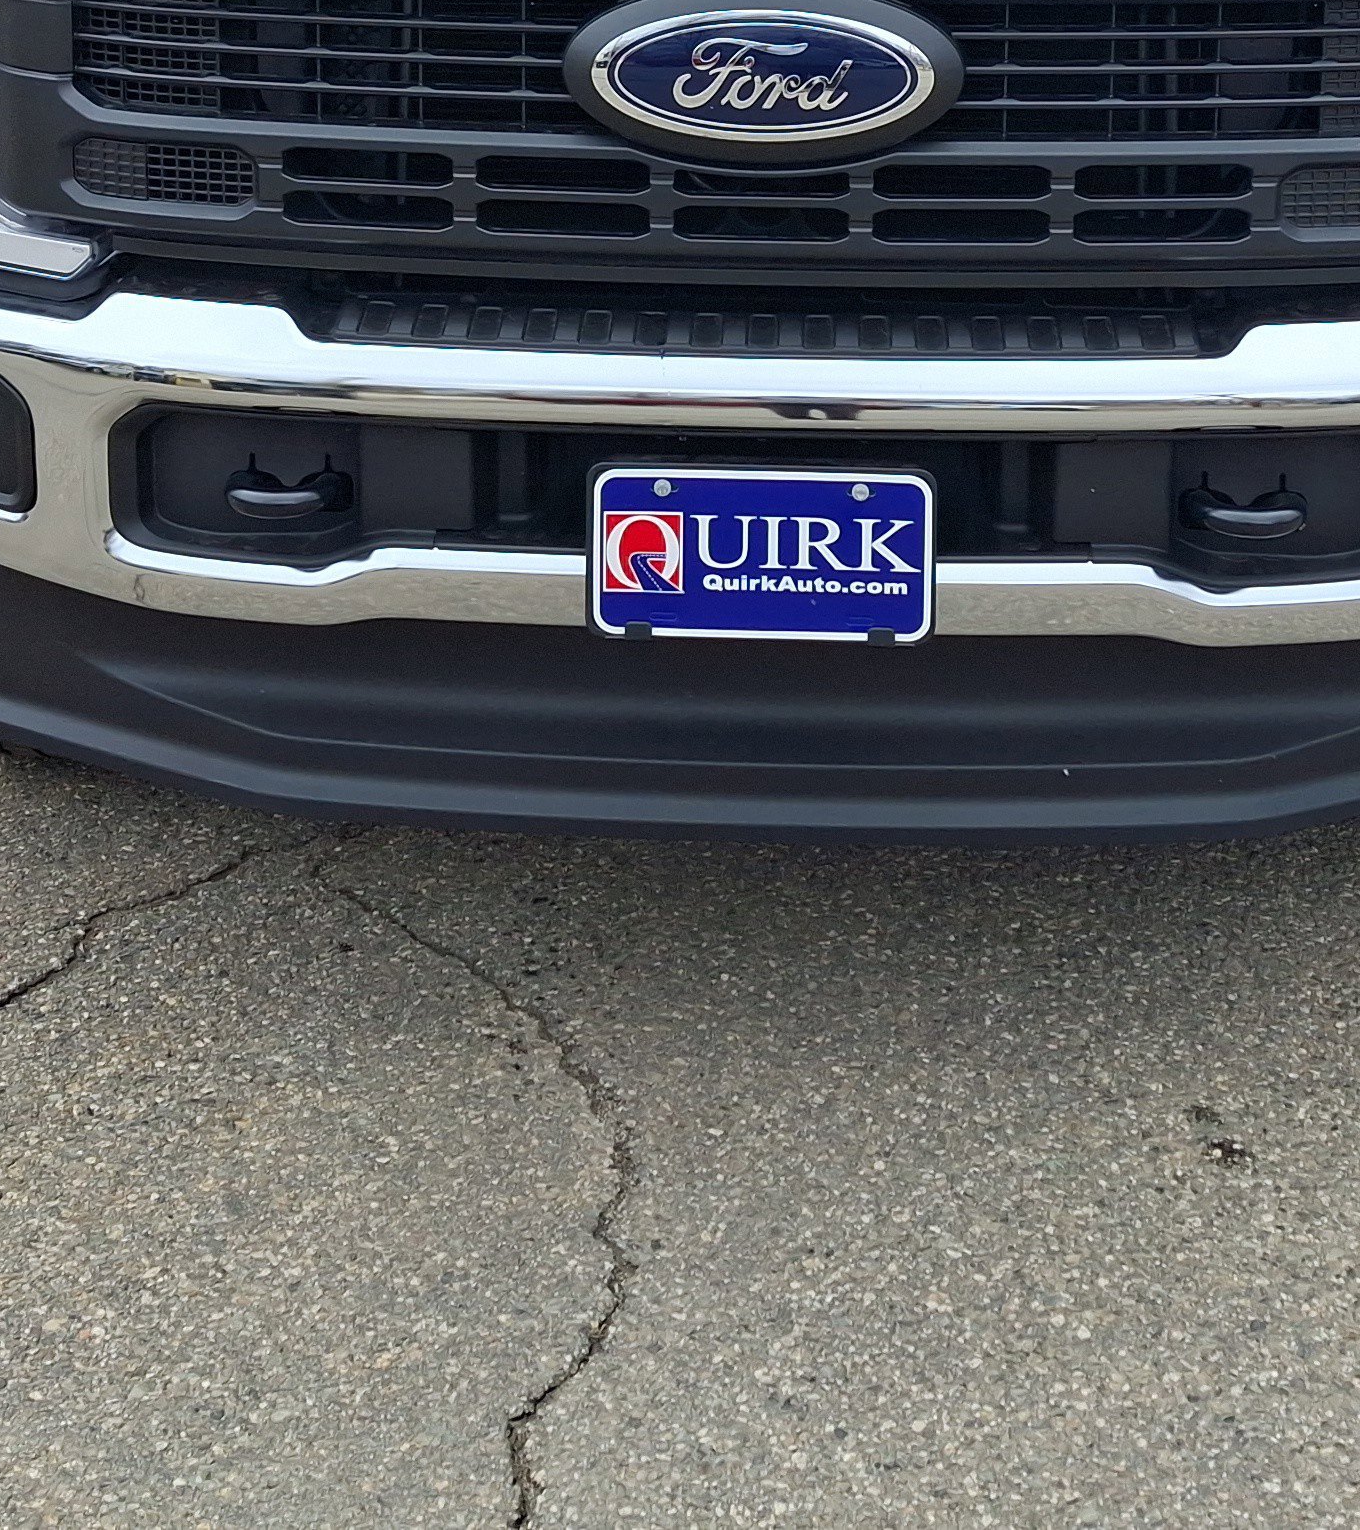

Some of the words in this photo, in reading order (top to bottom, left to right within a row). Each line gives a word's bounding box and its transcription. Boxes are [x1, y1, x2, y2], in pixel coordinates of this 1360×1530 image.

[673, 37, 852, 111] Ford
[604, 513, 921, 591] QUIRK
[703, 574, 908, 595] QuirkAuto.com
